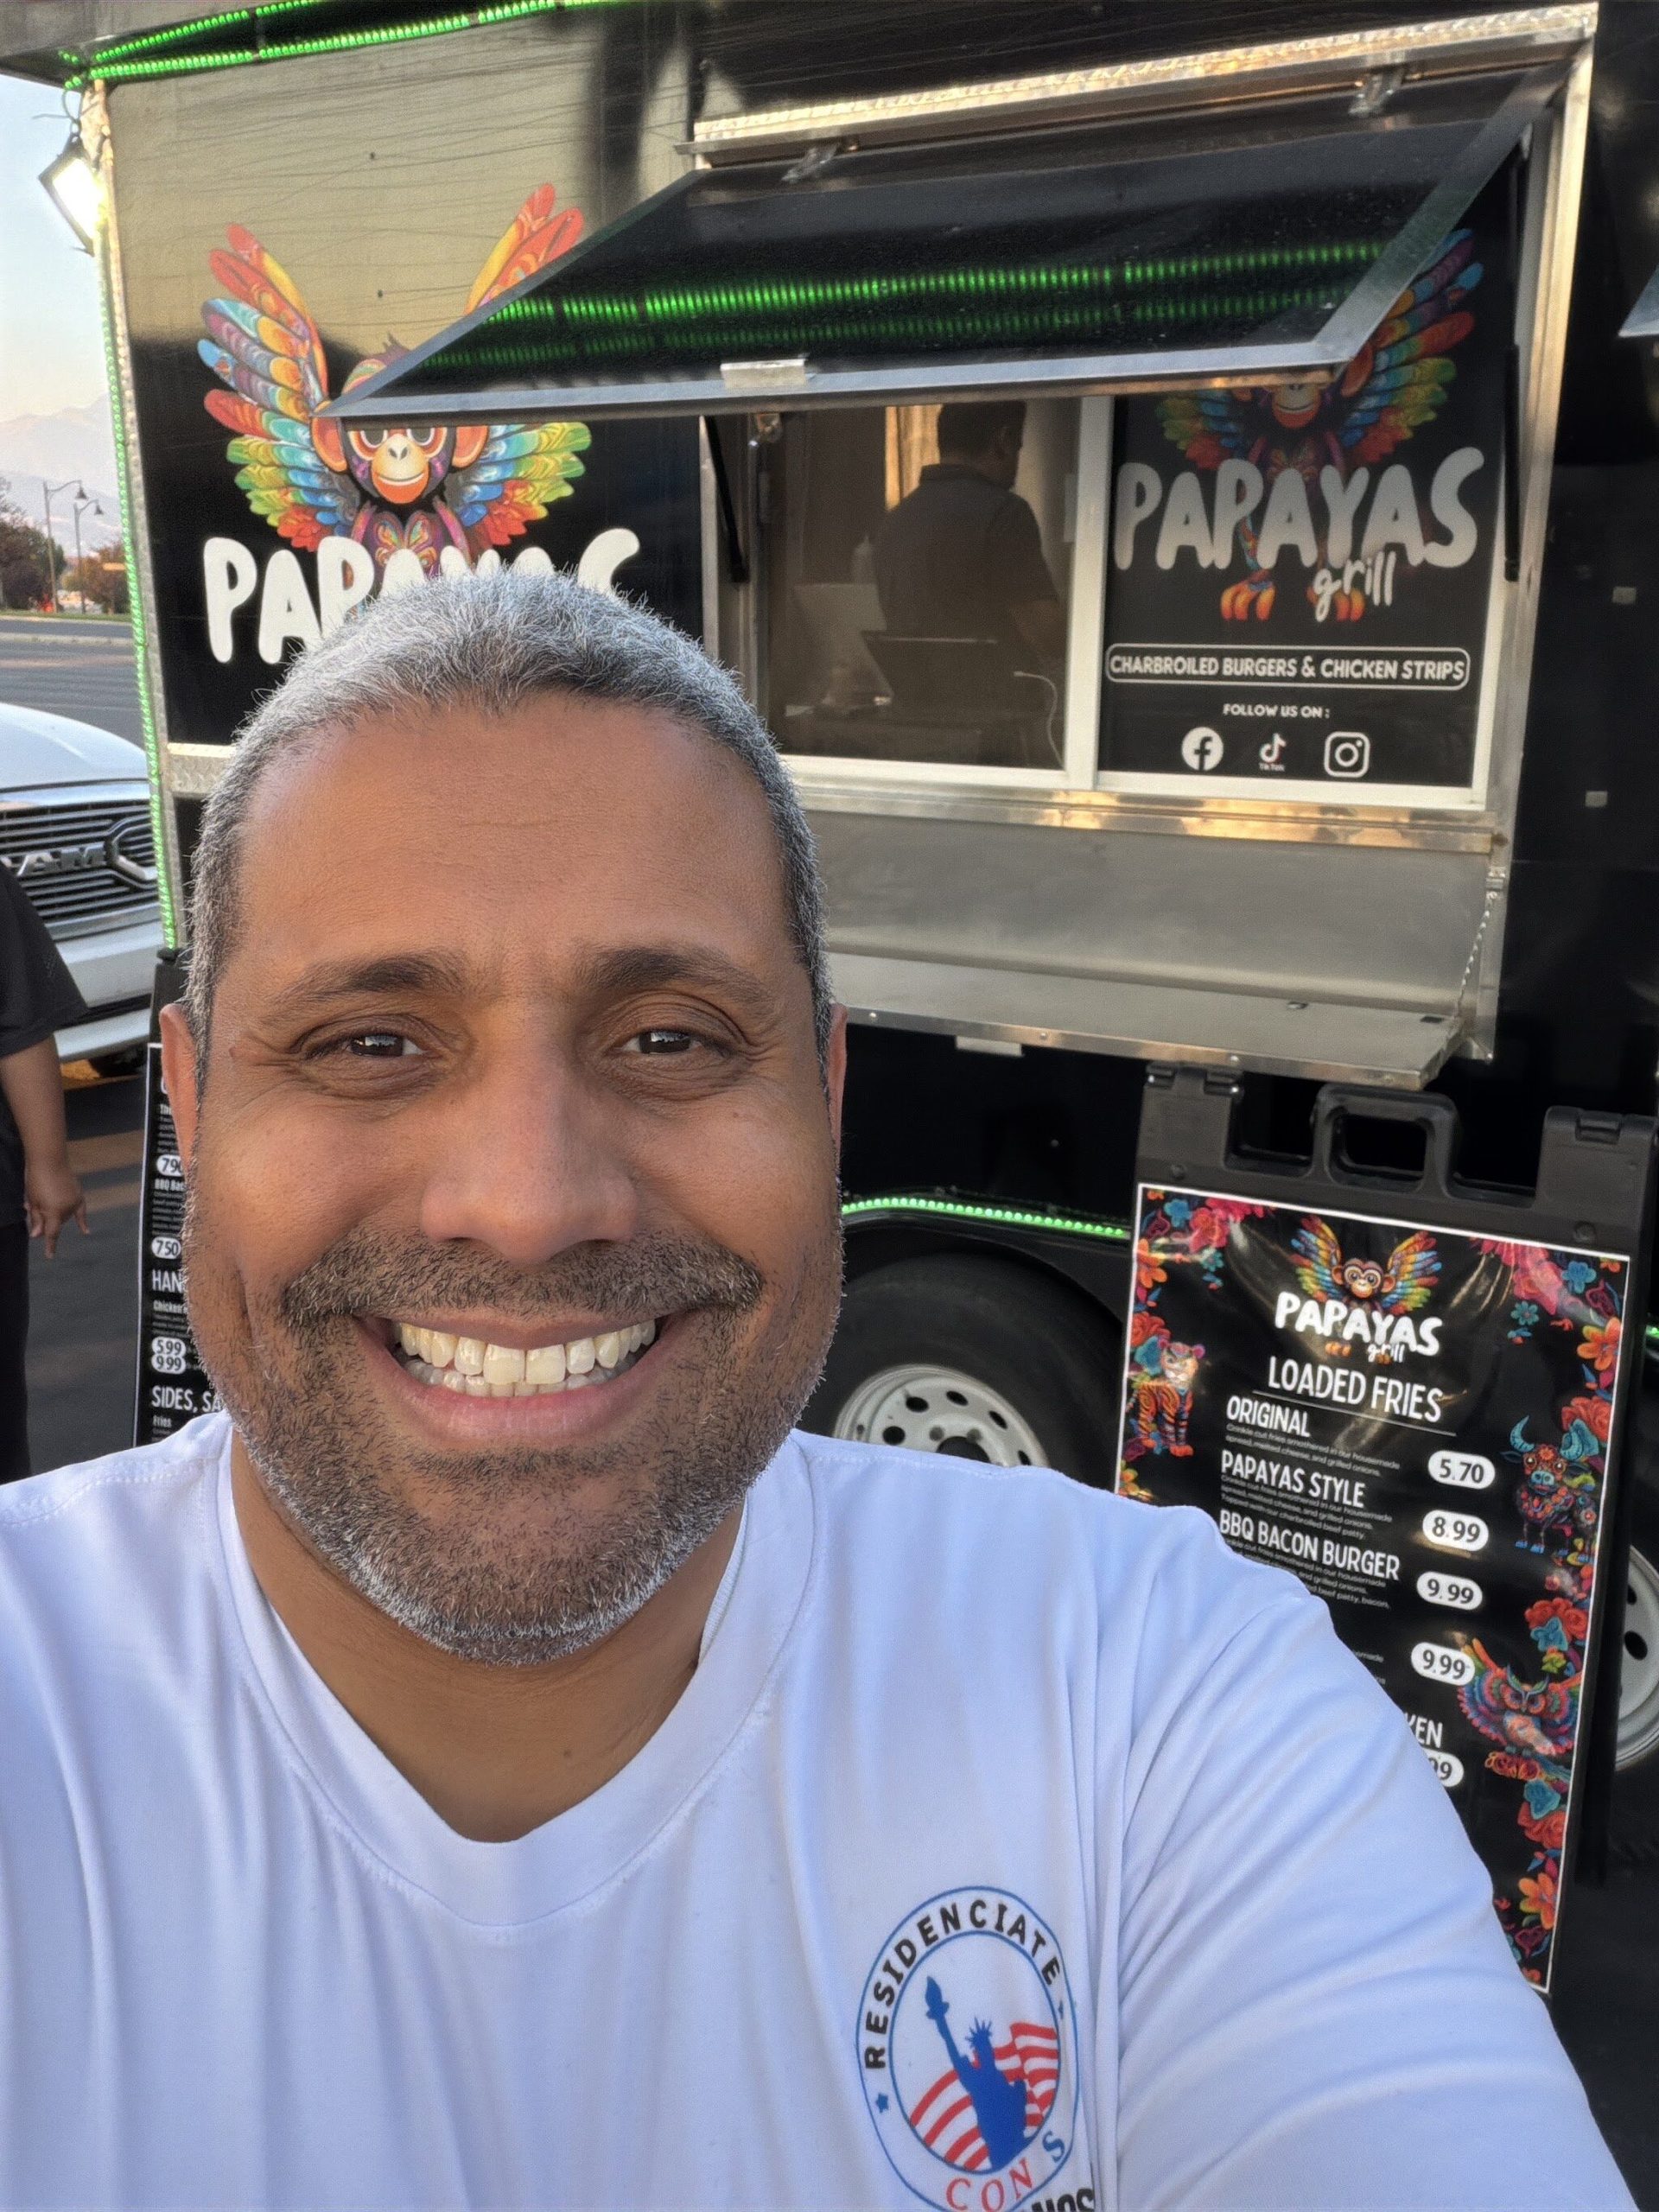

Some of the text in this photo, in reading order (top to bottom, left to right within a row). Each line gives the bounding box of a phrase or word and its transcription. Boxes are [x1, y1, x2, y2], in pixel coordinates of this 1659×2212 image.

[1114, 447, 1485, 570] PAPAYAS
[1312, 550, 1397, 622] grill
[1109, 655, 1465, 681] CHARBROILED BURGERS & CHICKEN STRIPS
[1223, 704, 1278, 716] FOLLOW
[1281, 705, 1297, 717] US
[1300, 706, 1322, 718] ON
[0, 841, 106, 877] AM
[1275, 1291, 1443, 1357] PAPAYAS
[1226, 1395, 1311, 1438] ORIGINAL
[1268, 1356, 1444, 1422] LOADED FRIES
[1221, 1450, 1366, 1508] PAPAYAS STYLE
[1219, 1509, 1254, 1541] BBQ
[1258, 1521, 1319, 1561] BACON
[1322, 1540, 1400, 1580] BURGER
[864, 1899, 1060, 2069] RESIDENCIATE
